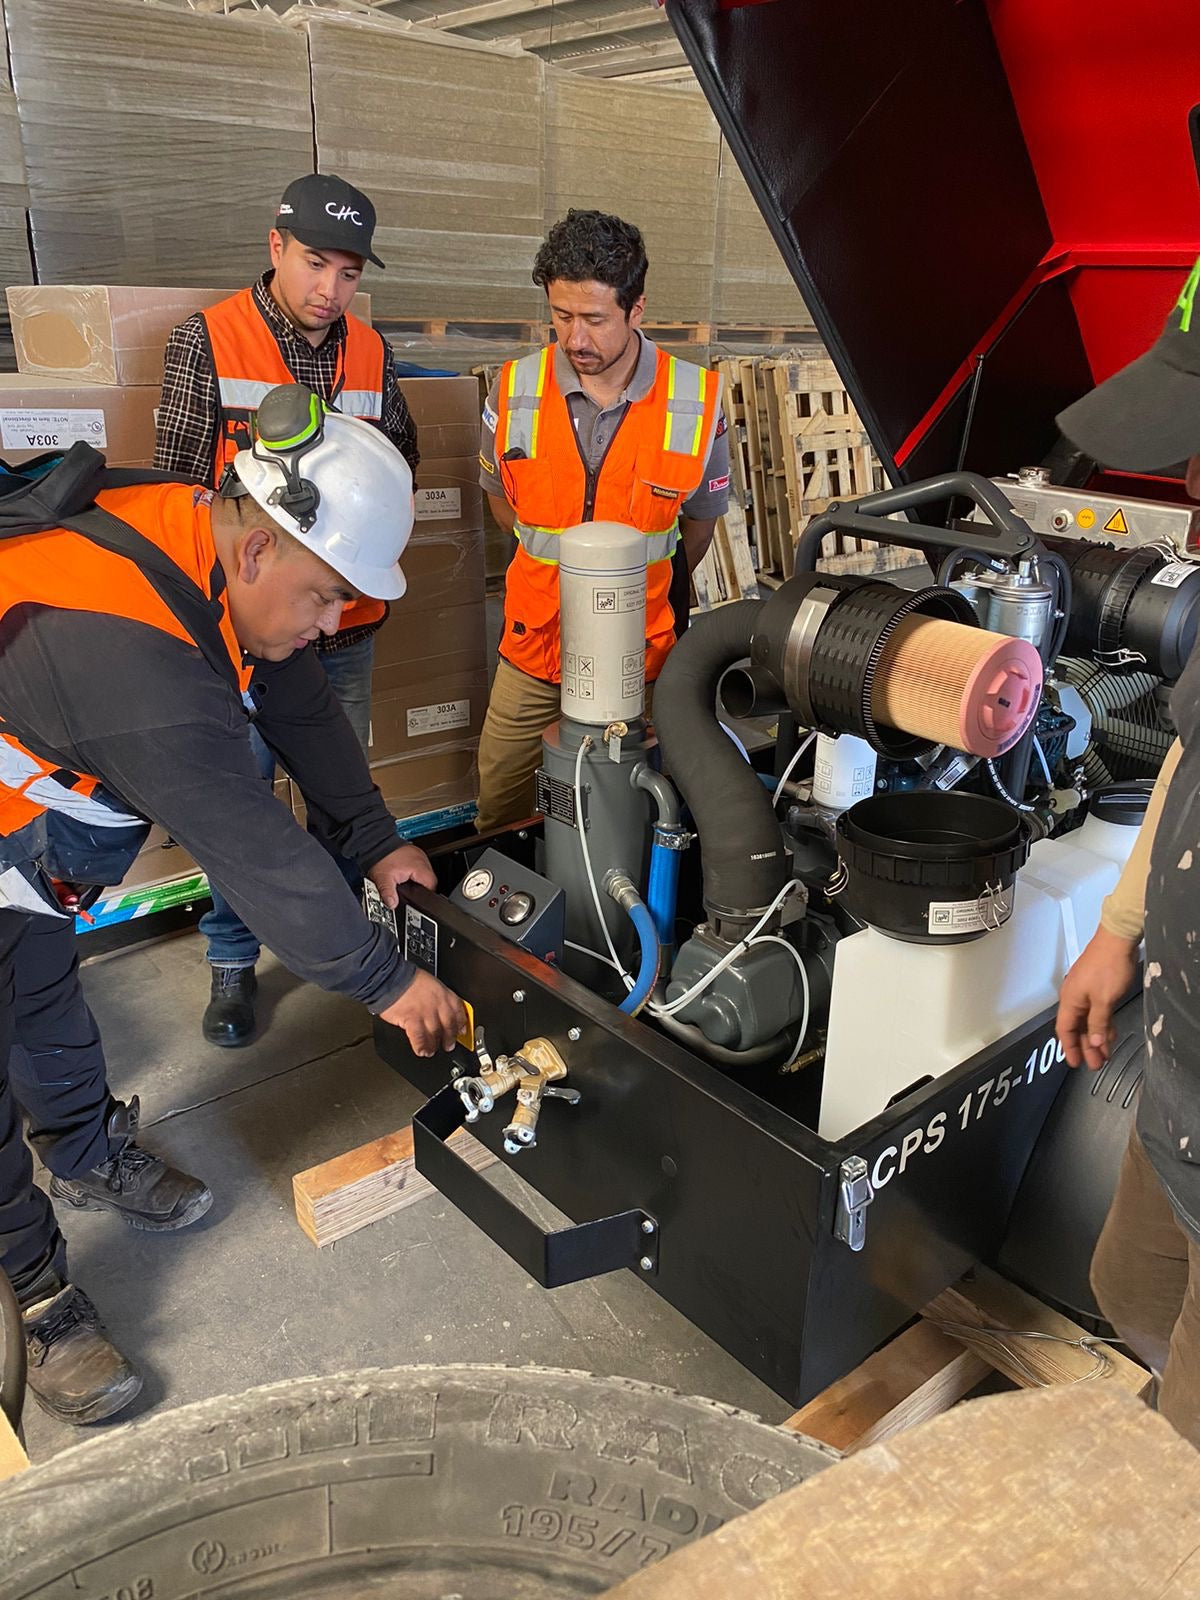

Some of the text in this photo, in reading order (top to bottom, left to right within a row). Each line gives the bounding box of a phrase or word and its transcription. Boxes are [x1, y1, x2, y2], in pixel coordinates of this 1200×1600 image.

[325, 202, 363, 226] CHC
[26, 434, 59, 446] 303A
[425, 491, 447, 500] 303A
[437, 704, 457, 714] 303A
[872, 1111, 947, 1190] CPS
